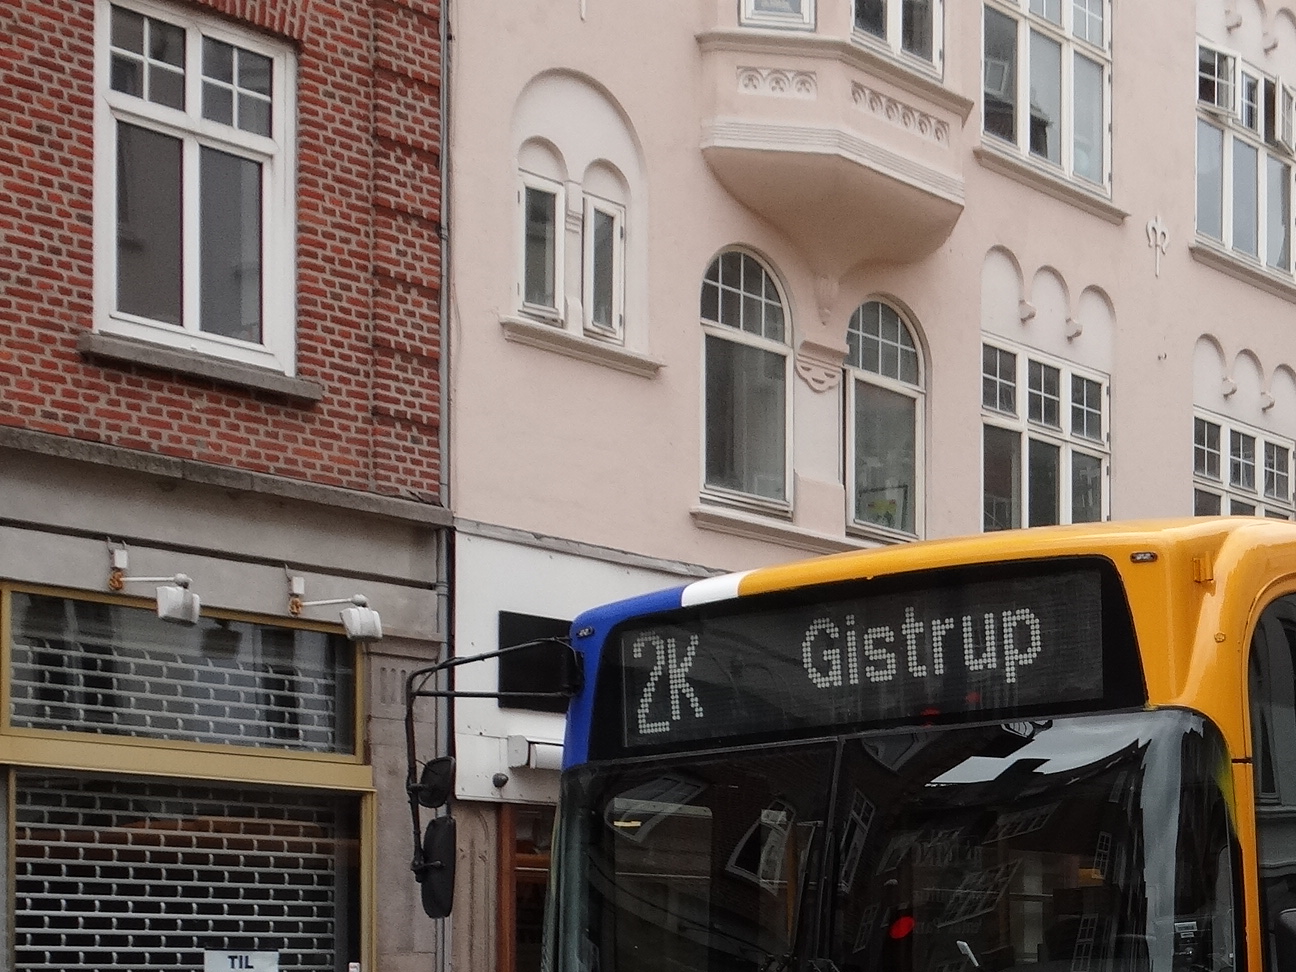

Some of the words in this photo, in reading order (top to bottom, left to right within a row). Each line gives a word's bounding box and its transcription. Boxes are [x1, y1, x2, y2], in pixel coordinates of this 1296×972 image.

[631, 631, 705, 735] 2K
[801, 606, 1043, 690] Gistrup
[227, 955, 254, 969] TIL
